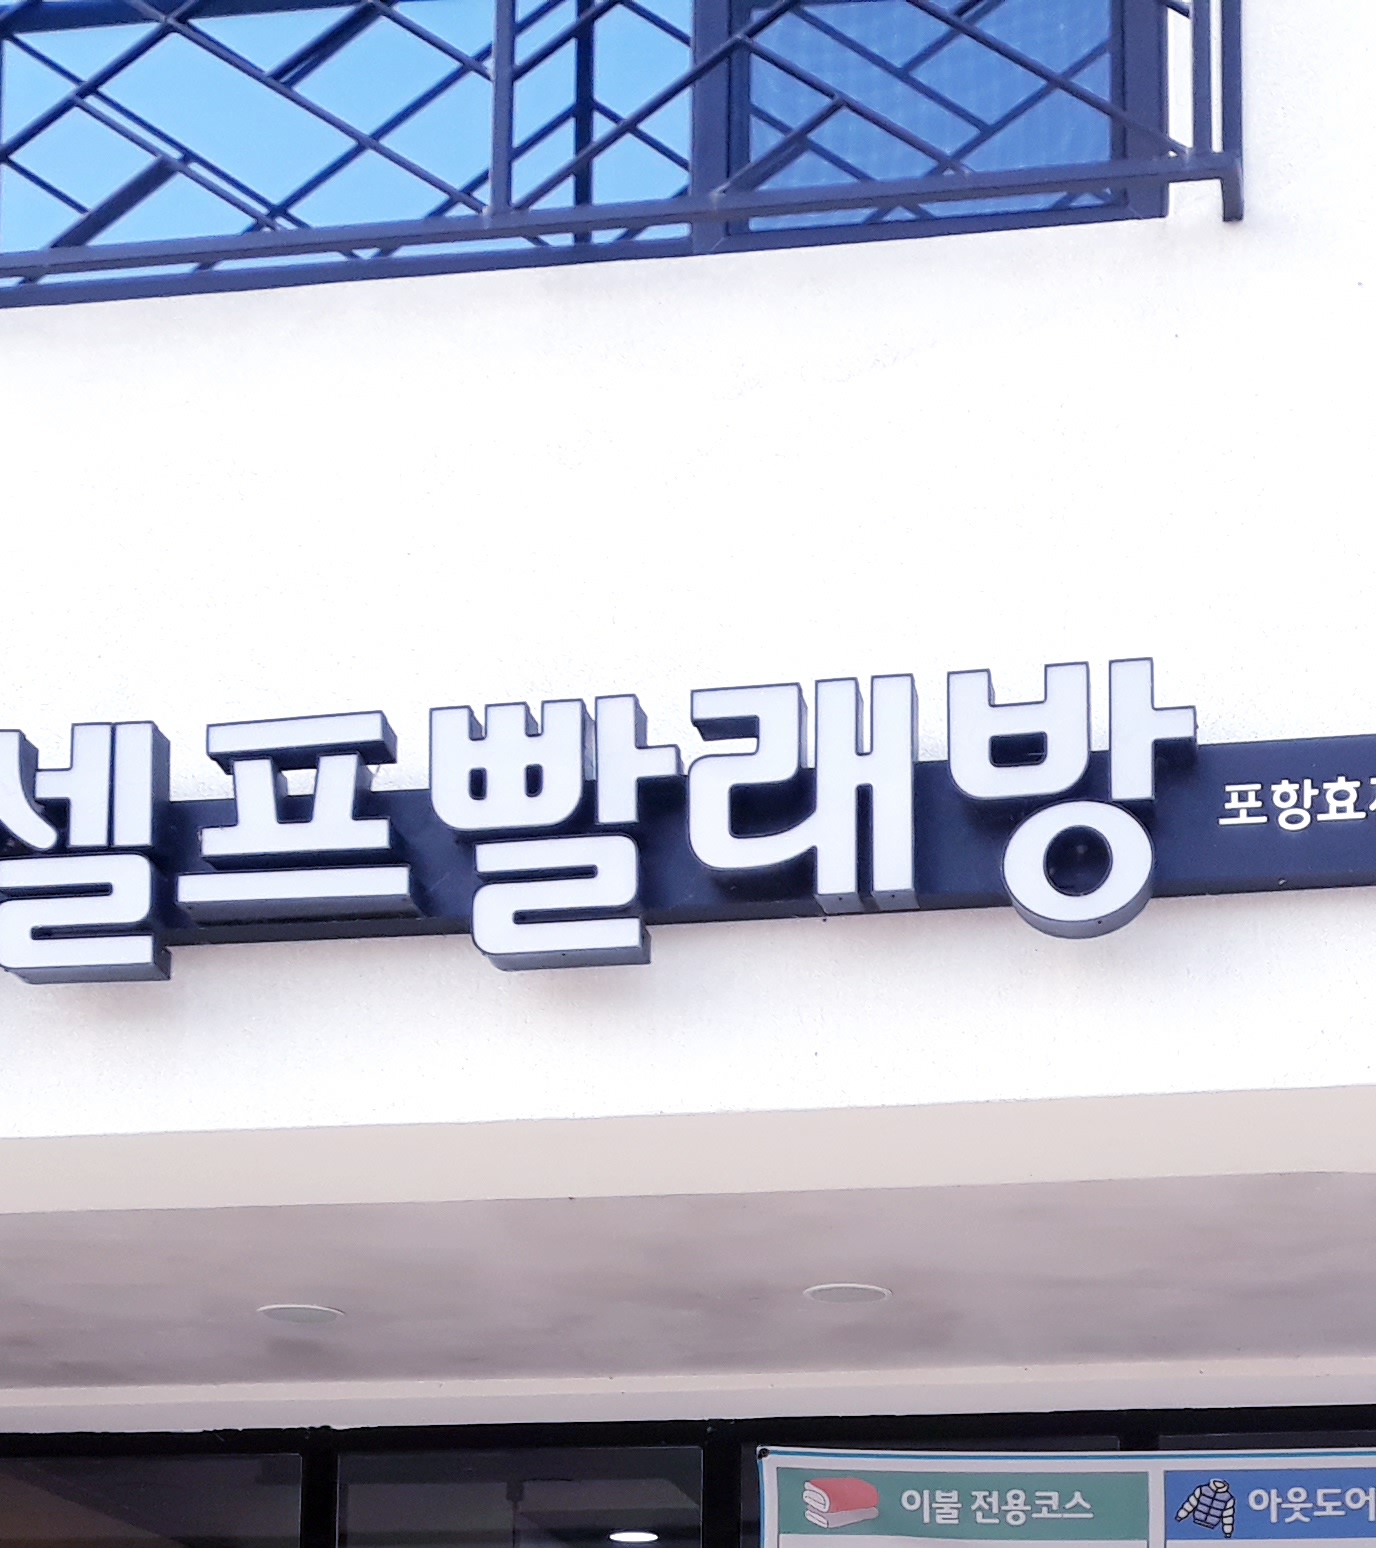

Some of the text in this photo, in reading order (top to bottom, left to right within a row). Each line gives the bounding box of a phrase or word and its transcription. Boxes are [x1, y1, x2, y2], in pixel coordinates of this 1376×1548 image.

[901, 1488, 1094, 1526] 이불 전용코스
[1247, 1485, 1376, 1523] 아웃도어
